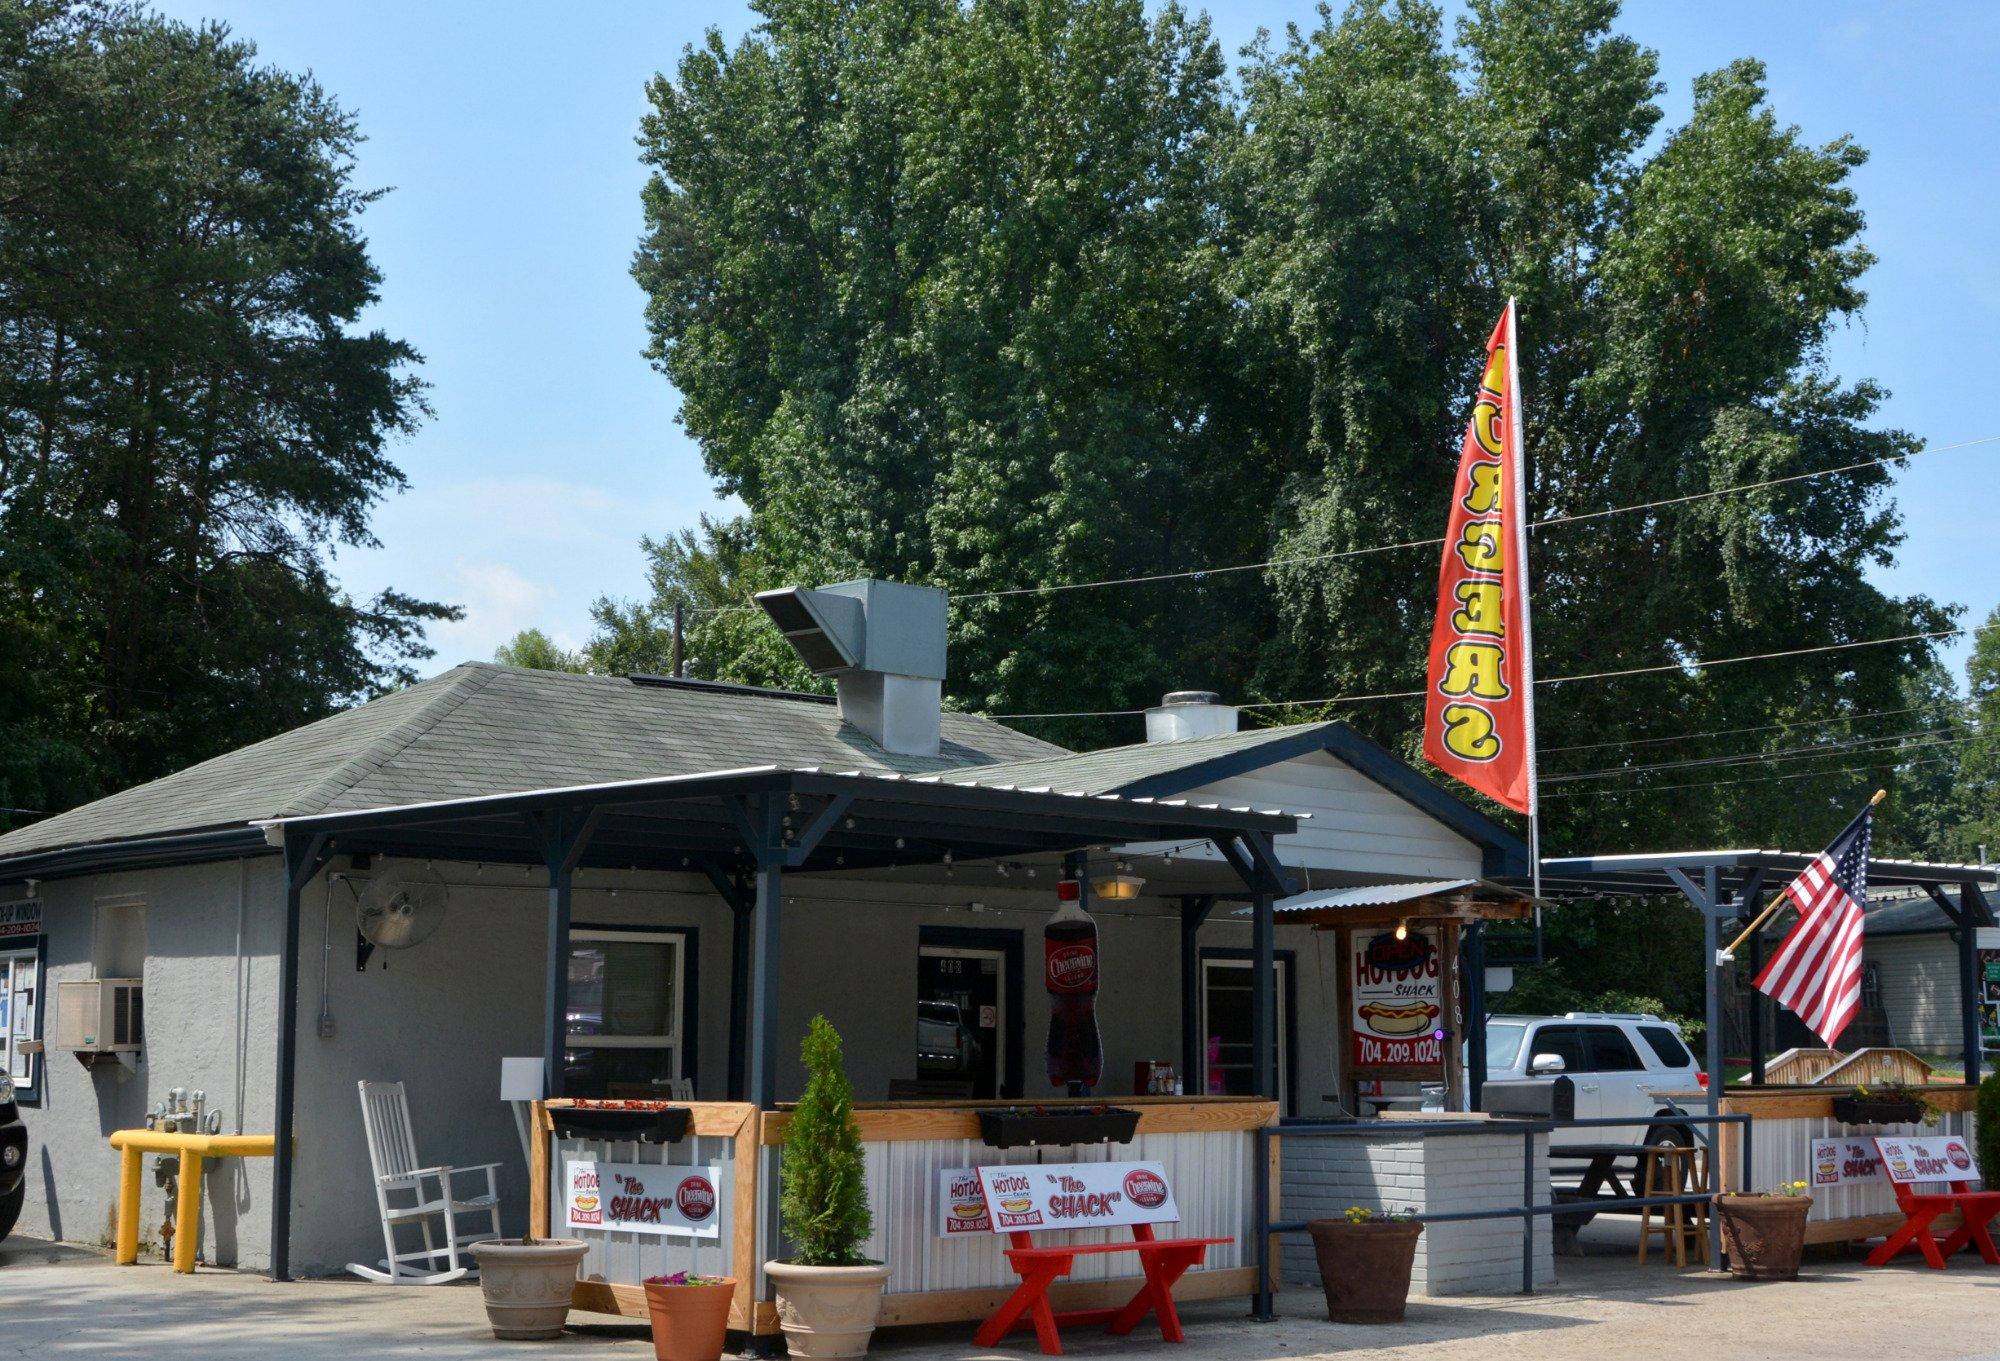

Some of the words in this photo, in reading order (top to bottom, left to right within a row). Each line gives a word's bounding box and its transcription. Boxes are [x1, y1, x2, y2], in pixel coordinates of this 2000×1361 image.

[1394, 984, 1436, 997] SHACK
[1359, 1036, 1441, 1063] 704.209.1024
[992, 1176, 1030, 1193] HOTDOG
[1126, 1179, 1165, 1199] Cheerwine
[679, 1186, 713, 1207] Cheerwine
